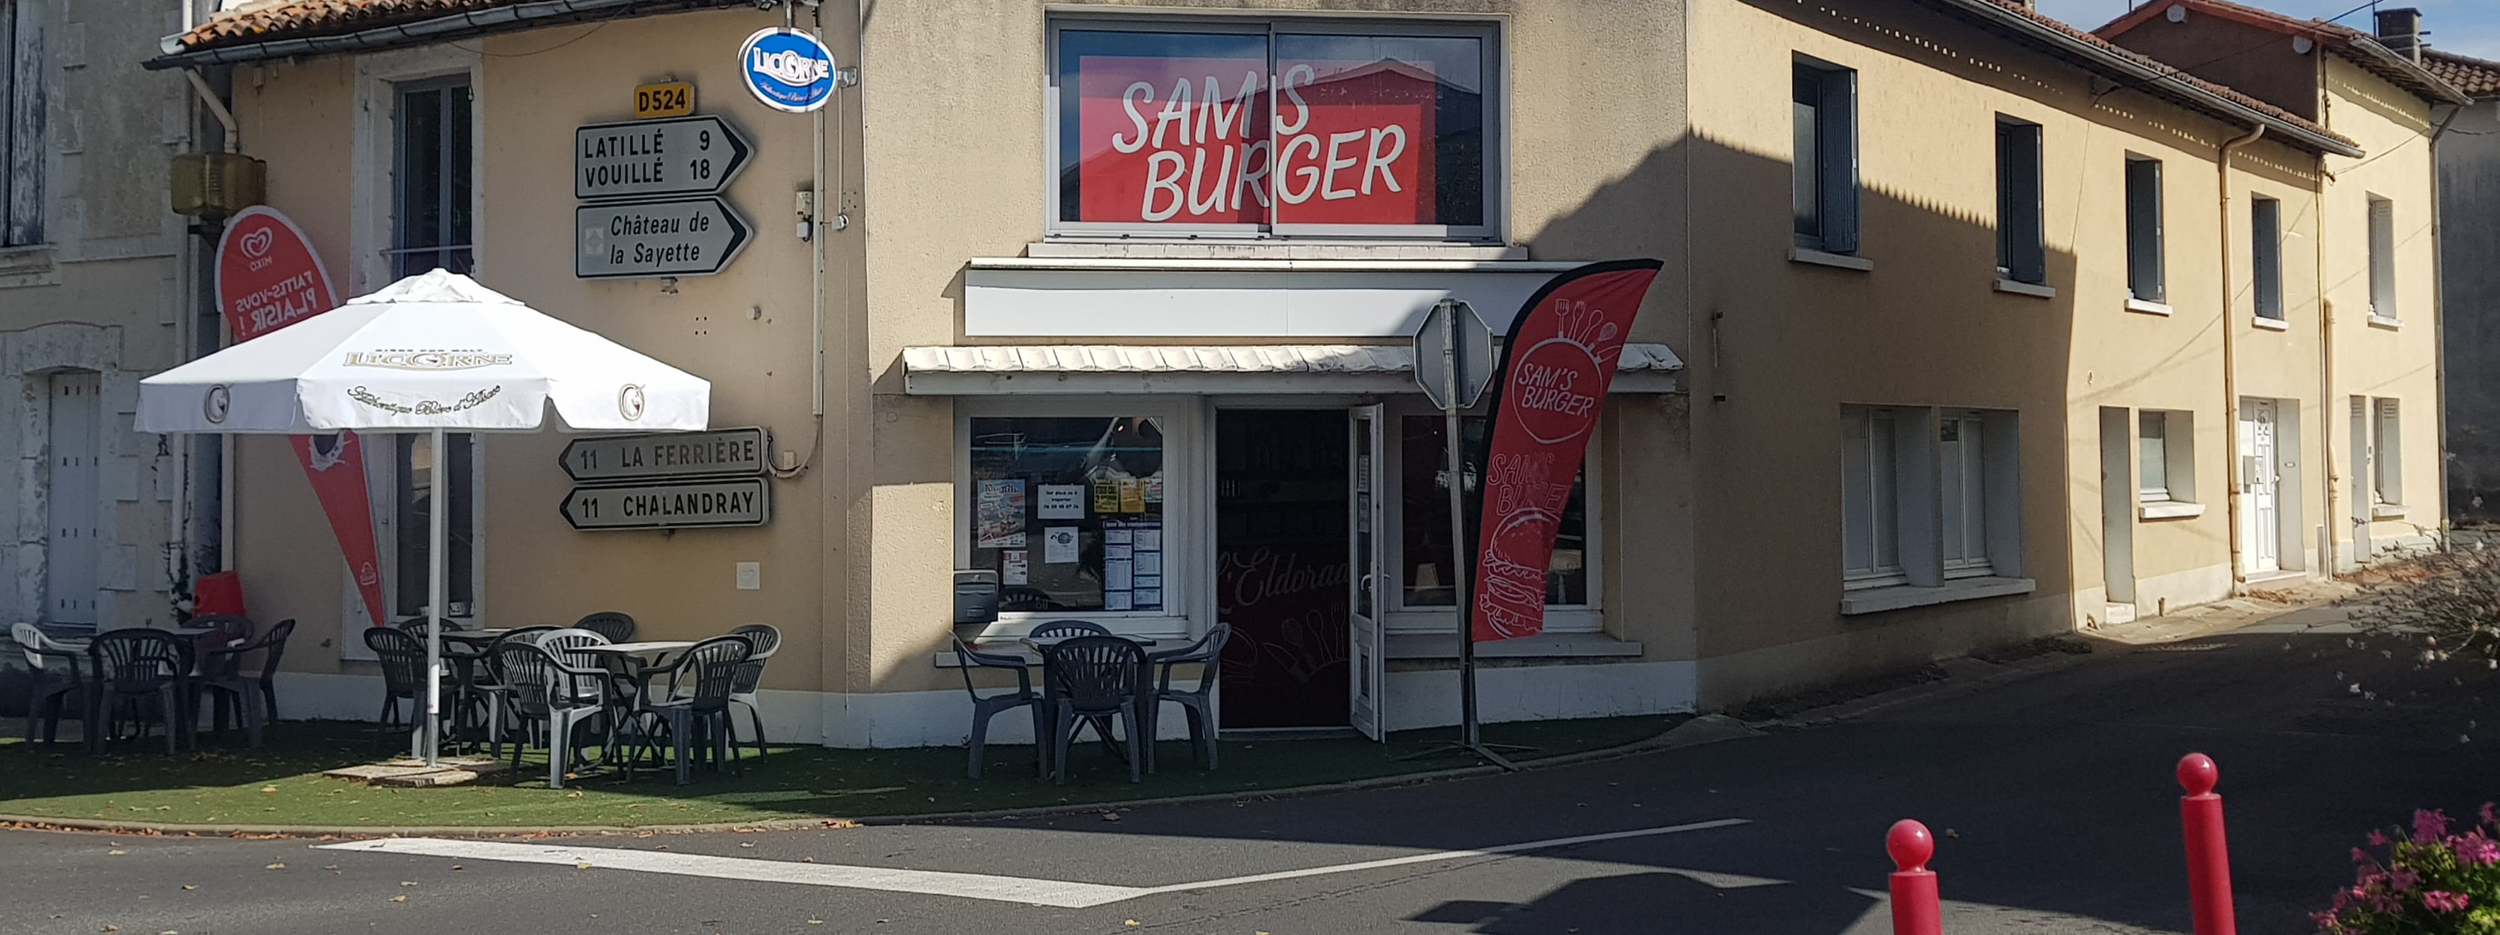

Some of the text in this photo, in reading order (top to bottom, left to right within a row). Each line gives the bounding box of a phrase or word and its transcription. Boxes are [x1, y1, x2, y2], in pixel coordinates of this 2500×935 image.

[753, 47, 829, 81] LICORNE
[638, 88, 687, 112] D524
[1112, 64, 1315, 154] SAMS
[584, 128, 710, 159] LATILLÉ 9
[585, 157, 710, 188] VOUILLÉ 18
[1142, 124, 1407, 222] BURGER
[610, 211, 709, 237] Château de
[610, 242, 700, 268] la Sayette
[343, 352, 513, 371] LICORNE
[1518, 362, 1579, 395] SAM'S
[1521, 386, 1595, 418] BURGER
[580, 437, 755, 470] 11 LA FERRIÈRE
[581, 491, 754, 518] 11 CHALANDRAY
